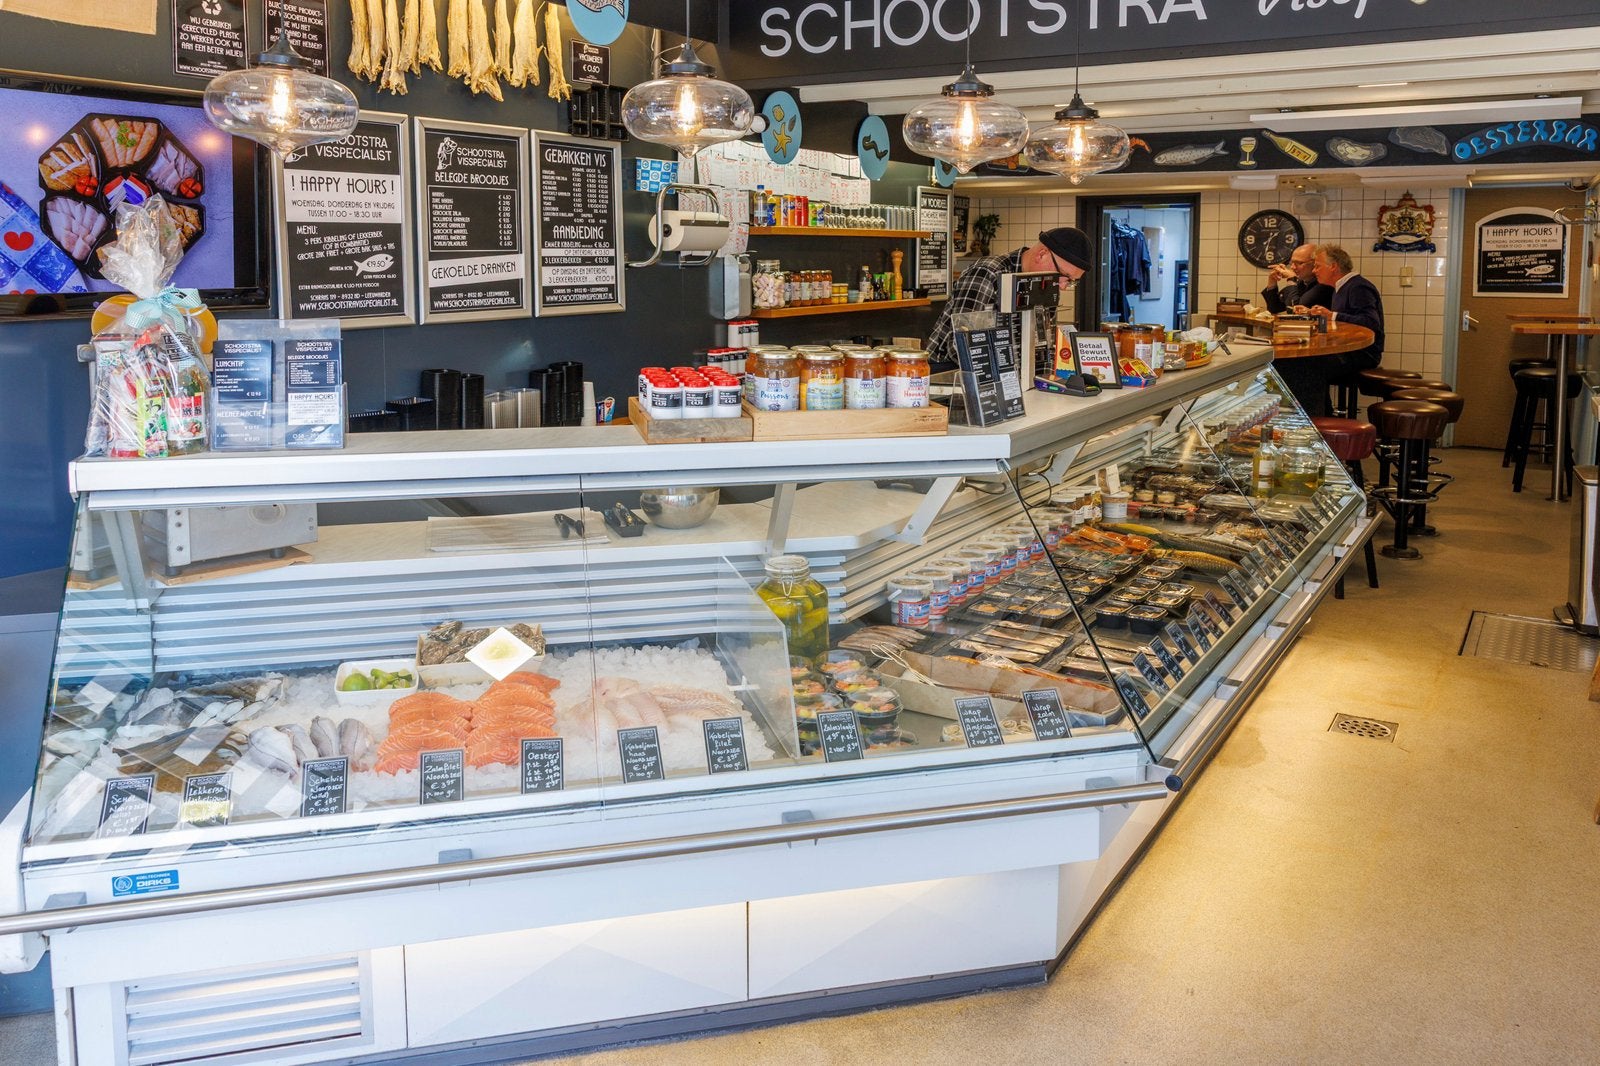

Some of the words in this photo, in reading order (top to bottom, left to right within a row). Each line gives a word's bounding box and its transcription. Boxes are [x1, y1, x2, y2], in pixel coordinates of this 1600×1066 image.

[190, 16, 201, 25] WIJ
[202, 18, 232, 30] GEBRUIKEN
[181, 24, 218, 36] GERECYCLED
[219, 30, 240, 40] PLASTIC
[190, 34, 214, 44] WERKEN
[215, 38, 231, 47] OOK
[181, 42, 194, 51] AAN
[195, 44, 206, 53] EEN
[207, 45, 224, 55] BETER
[225, 49, 244, 58] MILIEU
[1454, 119, 1598, 160] OESTERBAR
[315, 145, 393, 162] VISSPECIALIST
[456, 146, 506, 159] SCHOOTSTRA
[544, 148, 592, 167] GEBAKKEN
[593, 152, 607, 168] VIS
[457, 156, 508, 169] VISSPECIALIST
[300, 175, 341, 193] HAPPY
[346, 177, 388, 195] HOURS
[435, 171, 469, 184] BELEGDE
[470, 174, 509, 186] BROODJES
[327, 200, 363, 209] DONDERDAG
[373, 202, 396, 210] VRIJDAG
[308, 209, 328, 218] TUSSEN
[371, 211, 385, 219] UUR
[1264, 218, 1277, 228] 12
[296, 225, 319, 236] MENU:
[324, 233, 348, 243] KIBBELING
[348, 232, 357, 240] OF
[357, 230, 385, 240] LEKKERBEK
[552, 224, 605, 240] AANBIEDING
[1491, 227, 1520, 238] HAPPY
[1522, 227, 1553, 237] HOURS
[1246, 235, 1256, 245] 9
[1285, 233, 1295, 244] 3
[297, 252, 316, 262] GROTE
[315, 250, 326, 260] ZAK
[326, 248, 340, 258] FRIET
[344, 246, 362, 257] GROTE
[1265, 251, 1275, 261] 6
[431, 264, 479, 280] GEKOELDE
[480, 260, 517, 275] DRANKEN
[1078, 342, 1103, 350] Betaal
[215, 360, 246, 369] LUNCHTIP
[527, 751, 560, 760] Oesters
[308, 773, 344, 788] Schelvis
[136, 877, 172, 888] DIRKS
